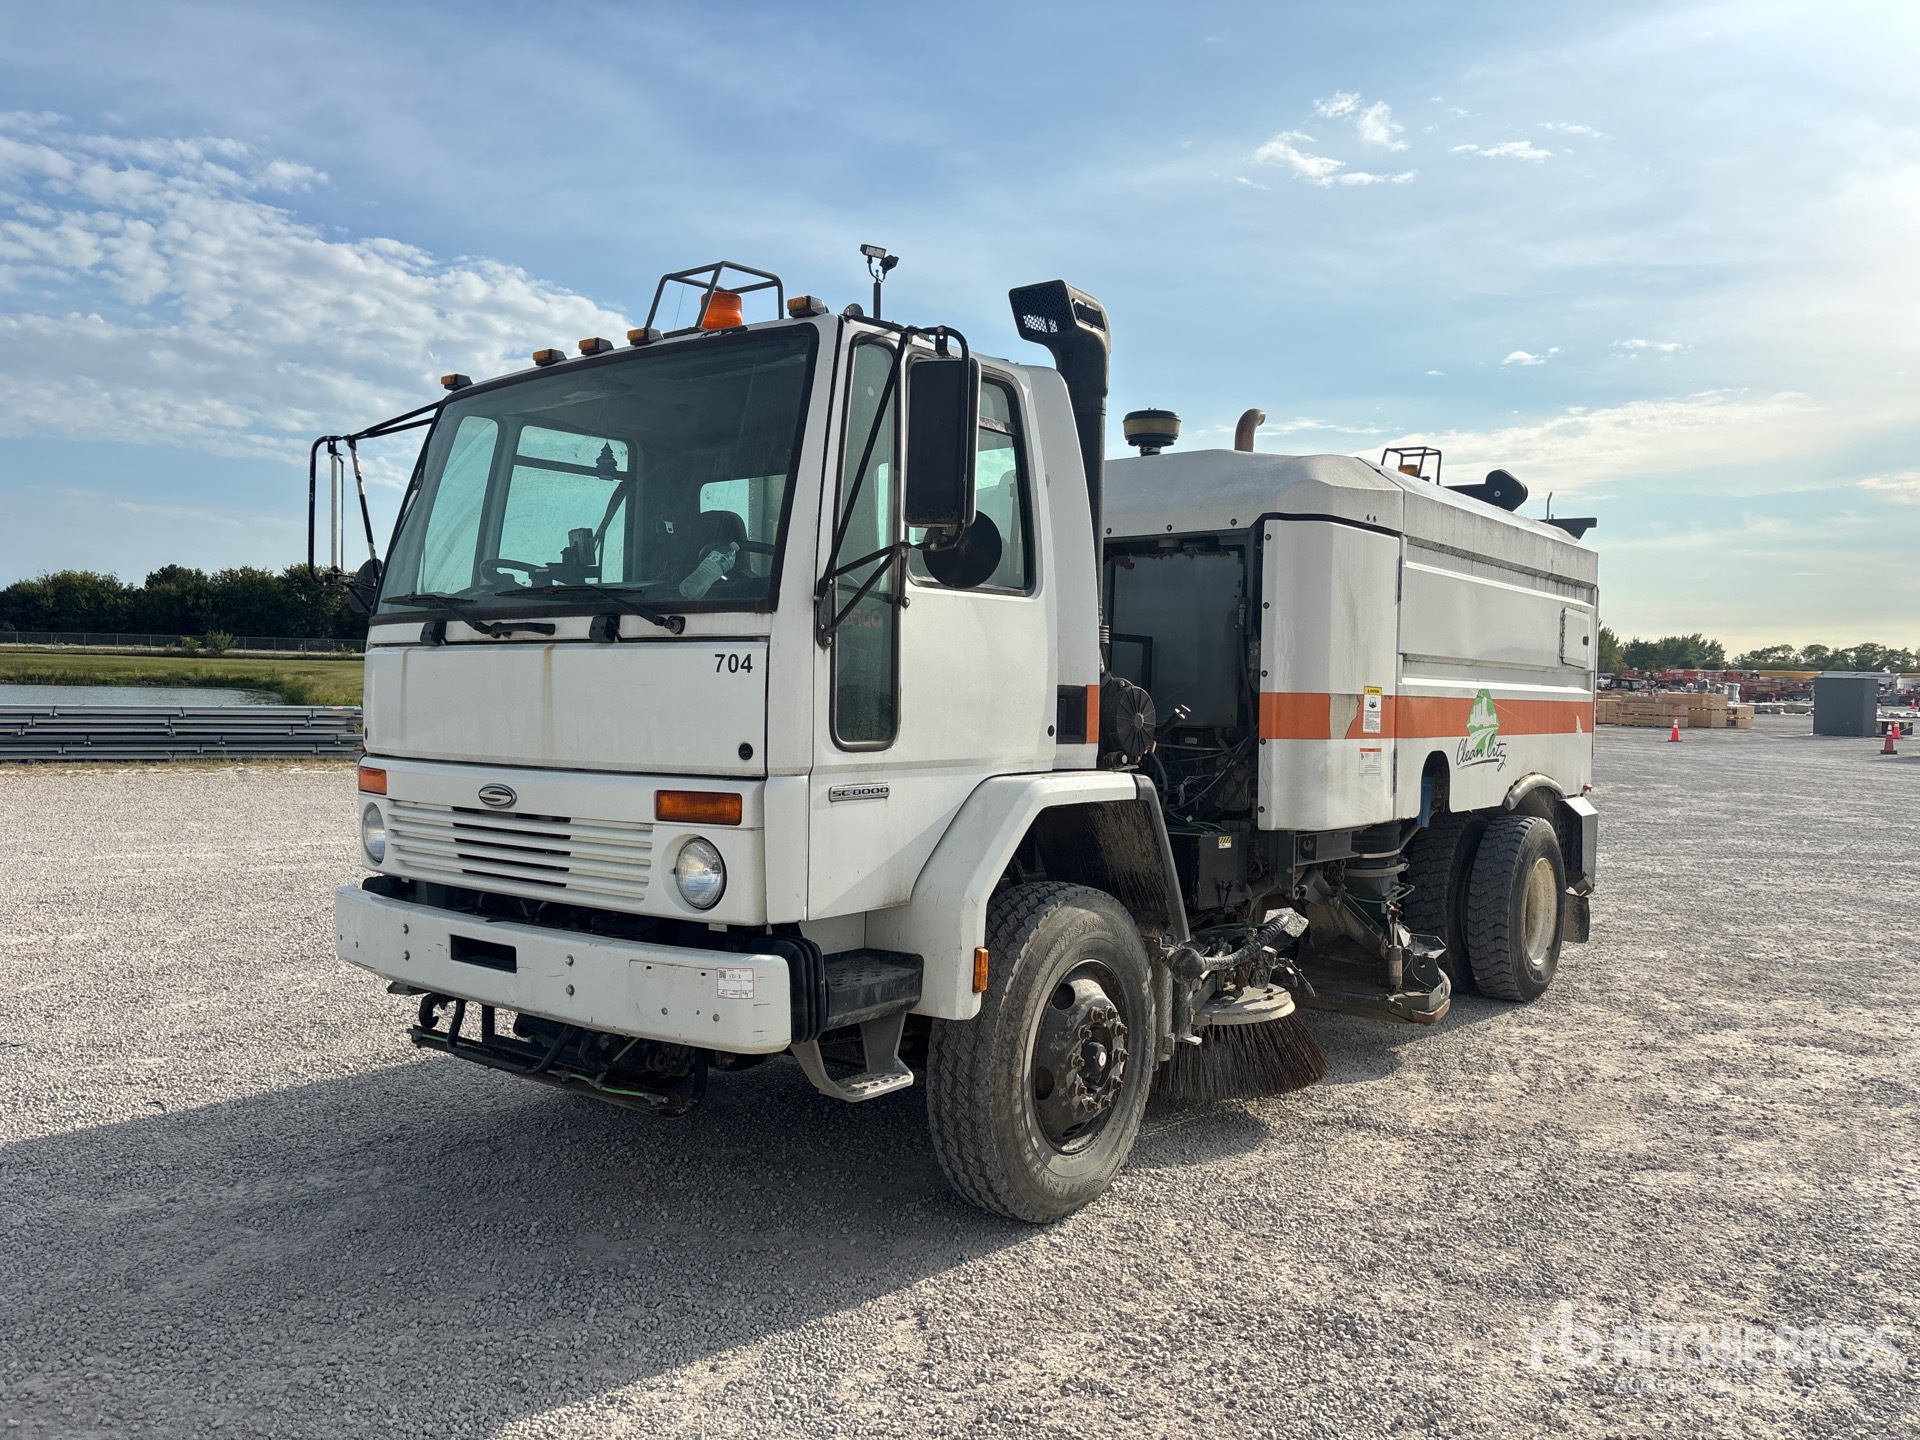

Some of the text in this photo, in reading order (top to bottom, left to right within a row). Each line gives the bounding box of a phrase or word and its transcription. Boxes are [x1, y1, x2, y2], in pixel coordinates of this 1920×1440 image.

[714, 653, 753, 673] 704
[1456, 733, 1507, 772] Clean City
[832, 786, 889, 797] SC8000
